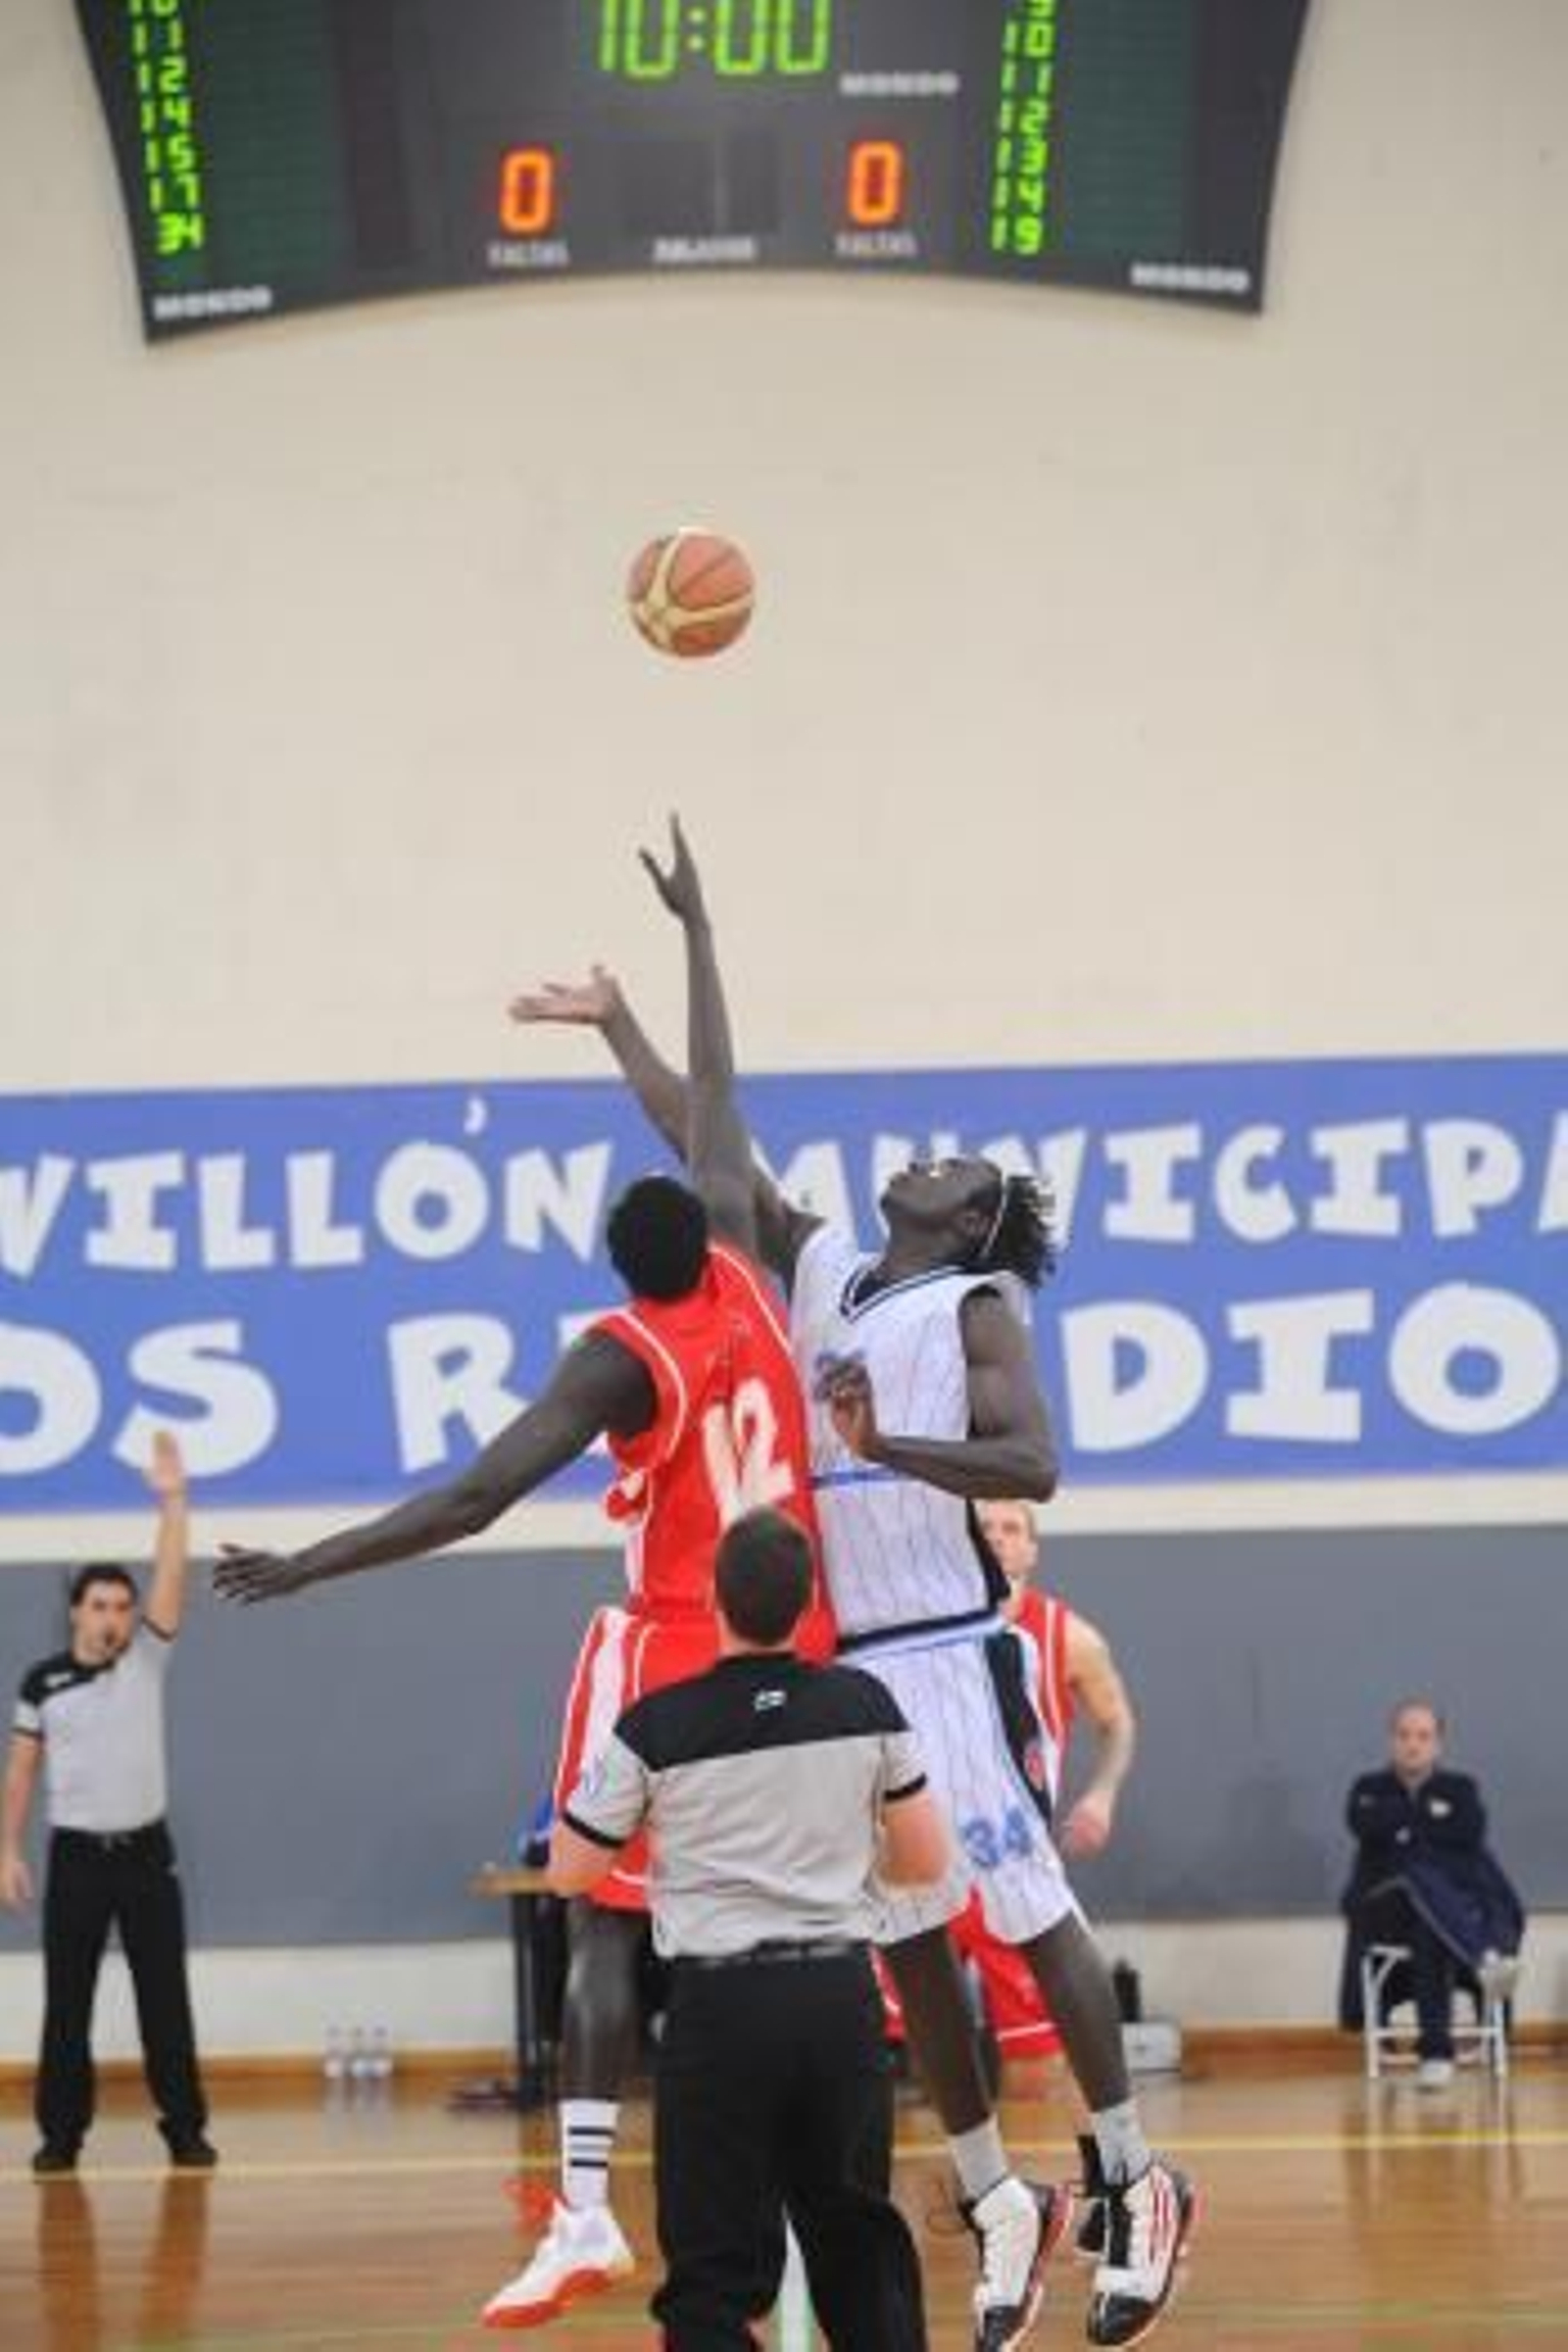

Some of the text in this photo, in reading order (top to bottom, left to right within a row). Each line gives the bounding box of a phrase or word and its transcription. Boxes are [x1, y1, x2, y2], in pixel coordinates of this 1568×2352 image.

[500, 148, 554, 233] 0
[849, 140, 903, 224] 0
[702, 1376, 796, 1527] 12
